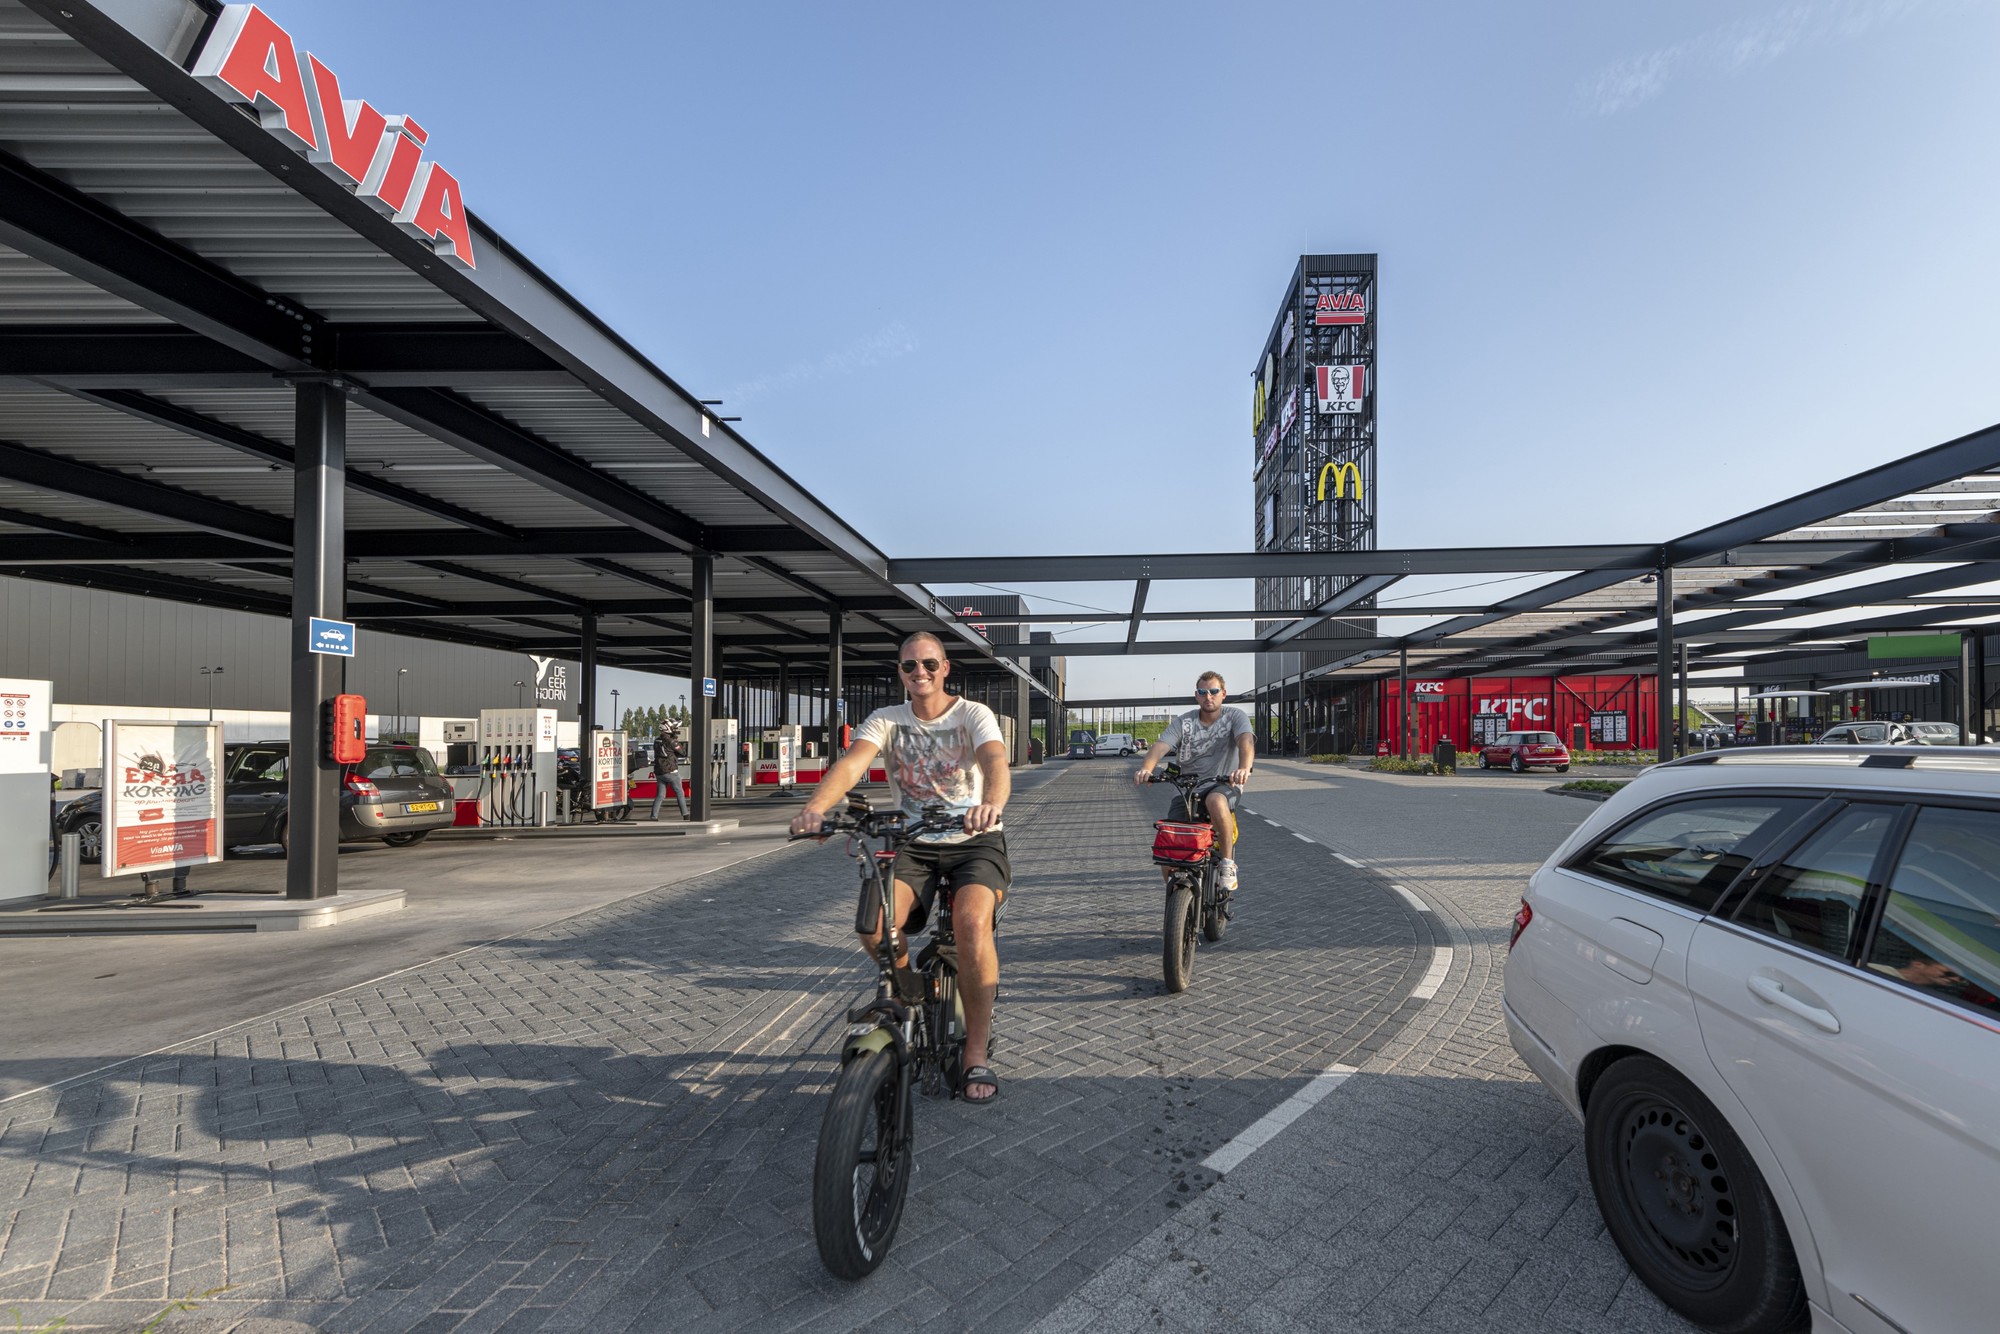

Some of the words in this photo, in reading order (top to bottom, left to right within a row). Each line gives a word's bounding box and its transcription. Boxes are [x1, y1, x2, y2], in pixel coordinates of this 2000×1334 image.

[1325, 402, 1355, 411] KFC
[554, 666, 566, 678] DE
[548, 677, 567, 689] EEK
[1414, 682, 1444, 693] KFC
[535, 687, 567, 701] HOORN
[1480, 698, 1549, 721] KFC
[598, 747, 623, 758] EXTRA
[598, 757, 623, 766] KORTING
